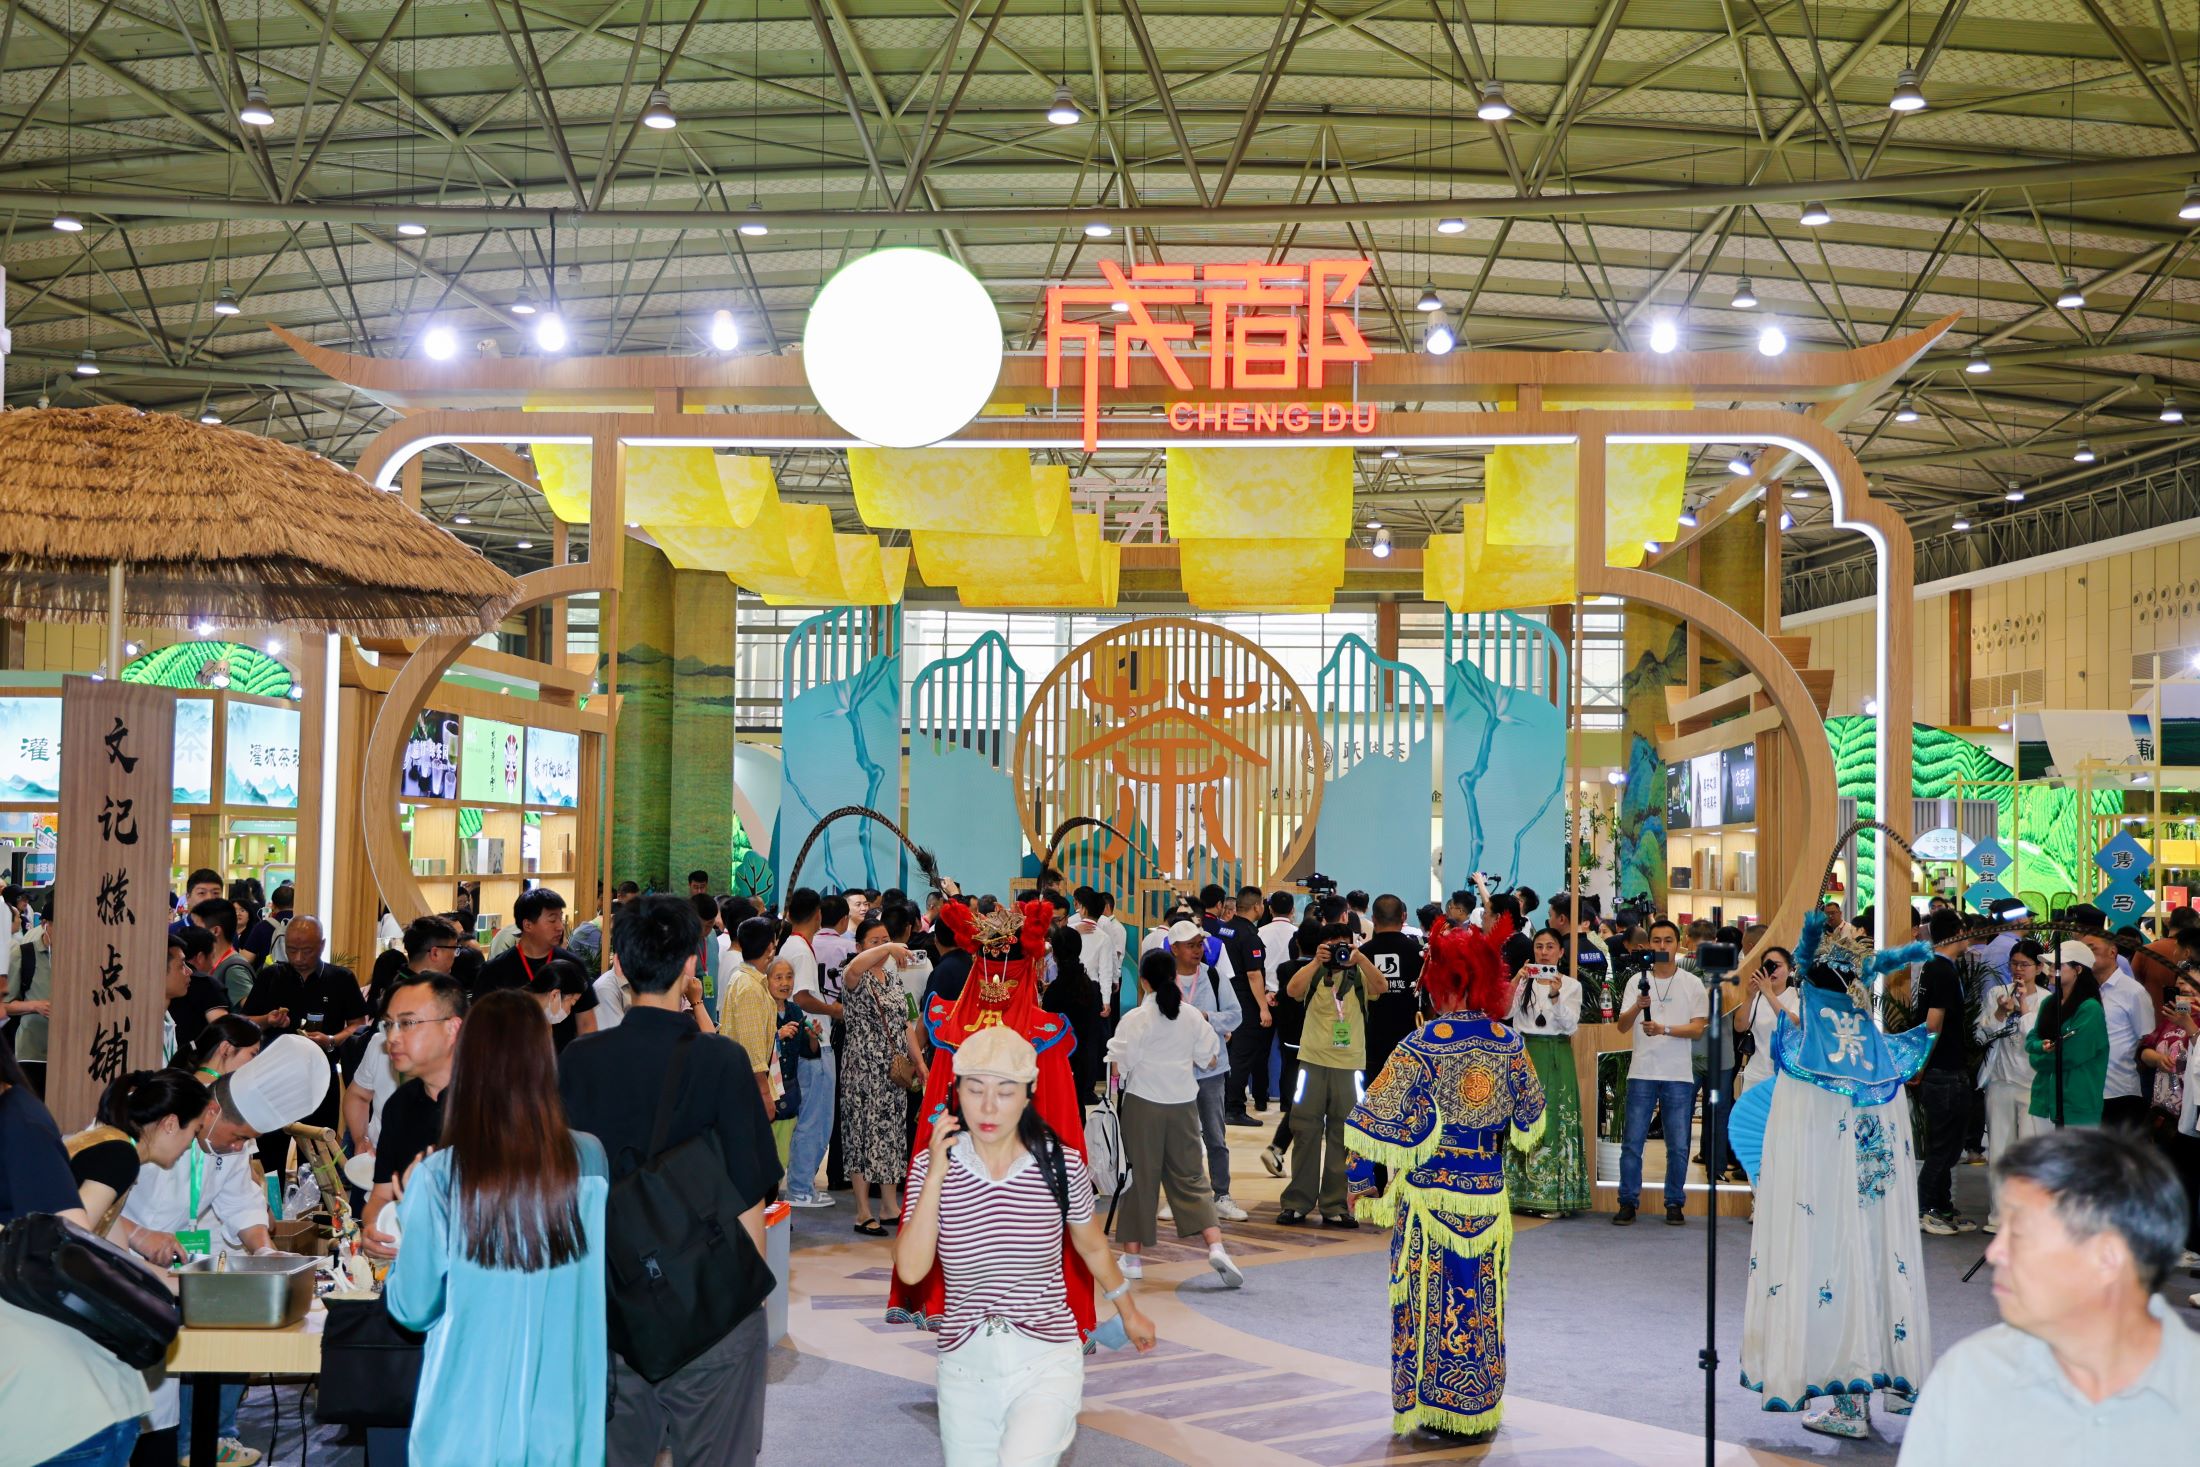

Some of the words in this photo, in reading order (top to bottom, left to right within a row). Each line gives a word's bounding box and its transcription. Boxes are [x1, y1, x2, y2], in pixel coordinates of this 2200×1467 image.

[1046, 259, 1374, 452] 成都
[1168, 401, 1309, 433] CHENG
[1322, 402, 1375, 433] DU
[88, 716, 139, 1084] 文记糕点铺
